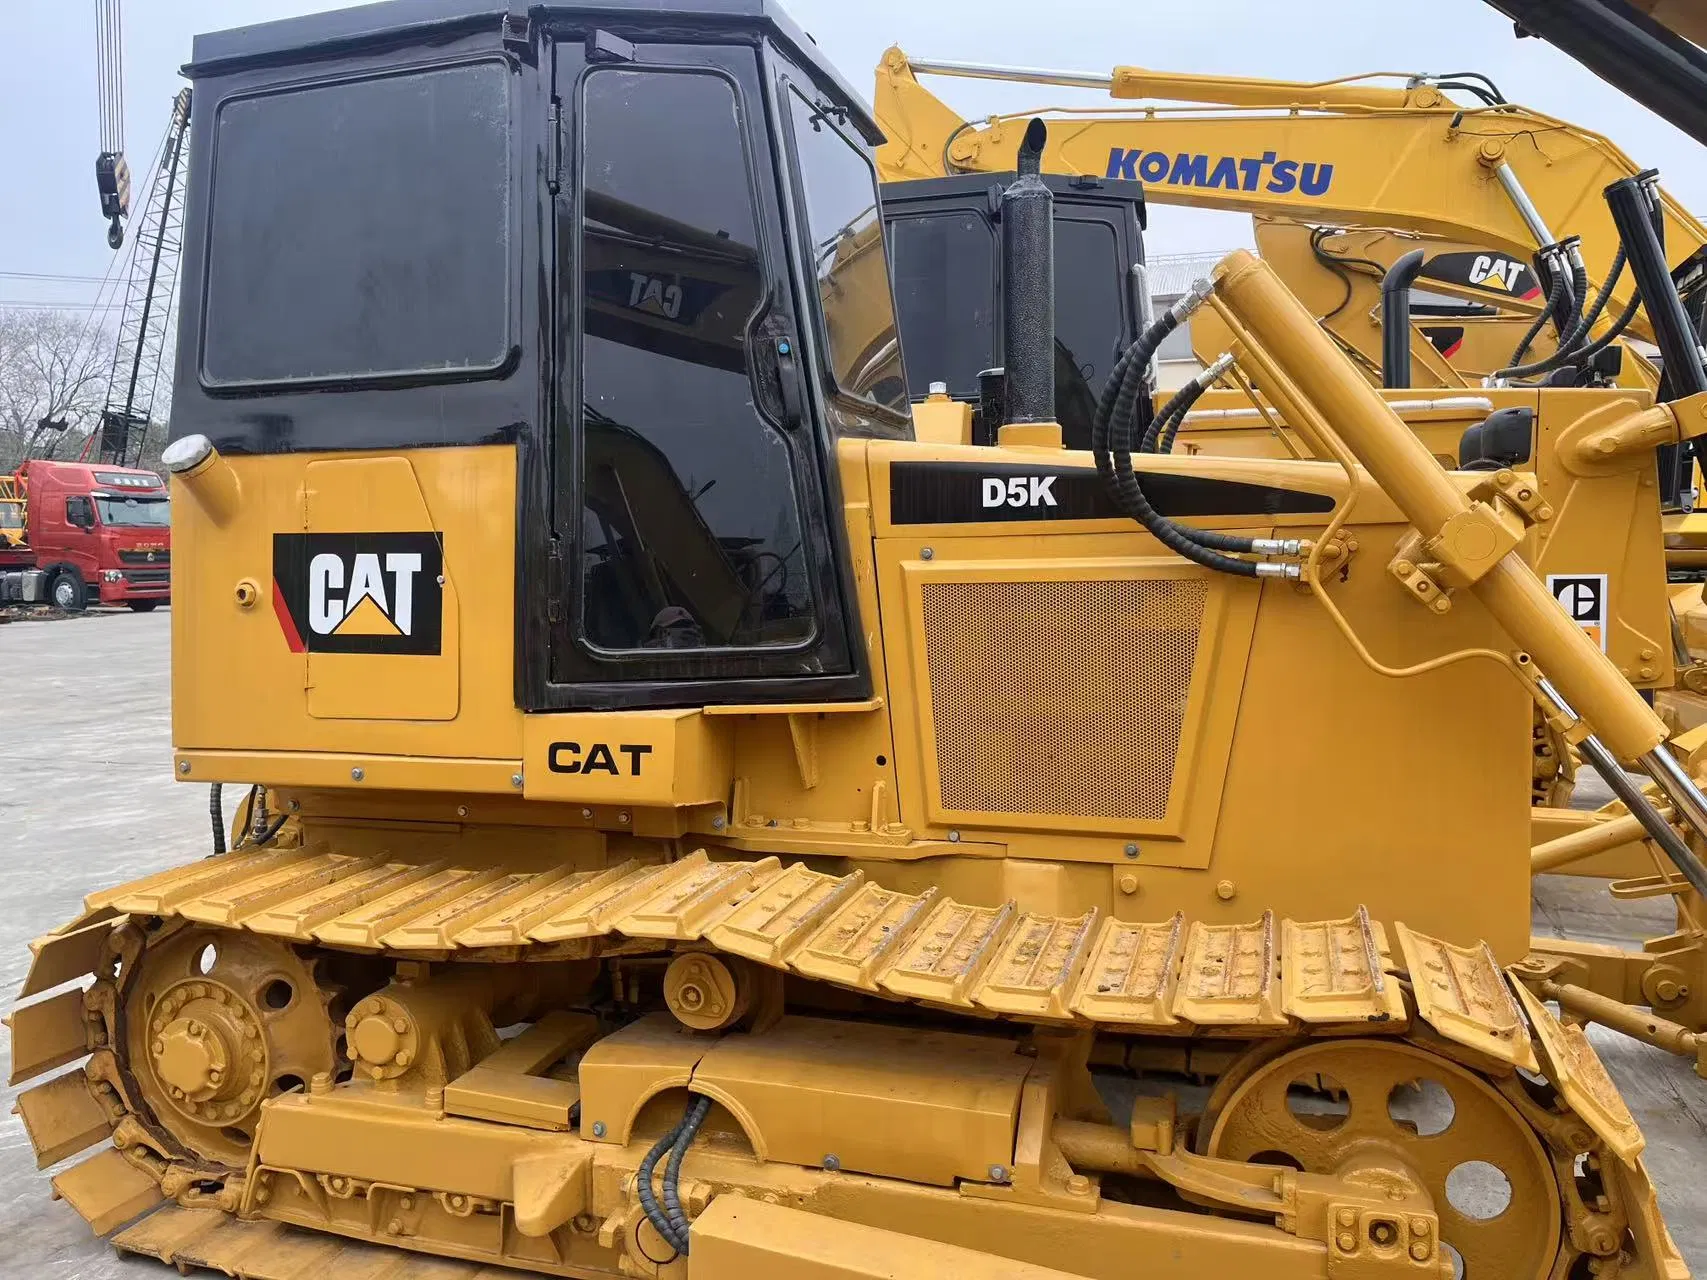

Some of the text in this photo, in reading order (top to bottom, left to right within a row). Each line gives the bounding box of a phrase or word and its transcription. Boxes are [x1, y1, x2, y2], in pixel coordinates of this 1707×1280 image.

[1106, 147, 1334, 196] KOMATSU
[1469, 255, 1525, 292] CAT
[982, 476, 1058, 508] D5K
[309, 553, 422, 636] CAT
[548, 741, 653, 776] CAT
